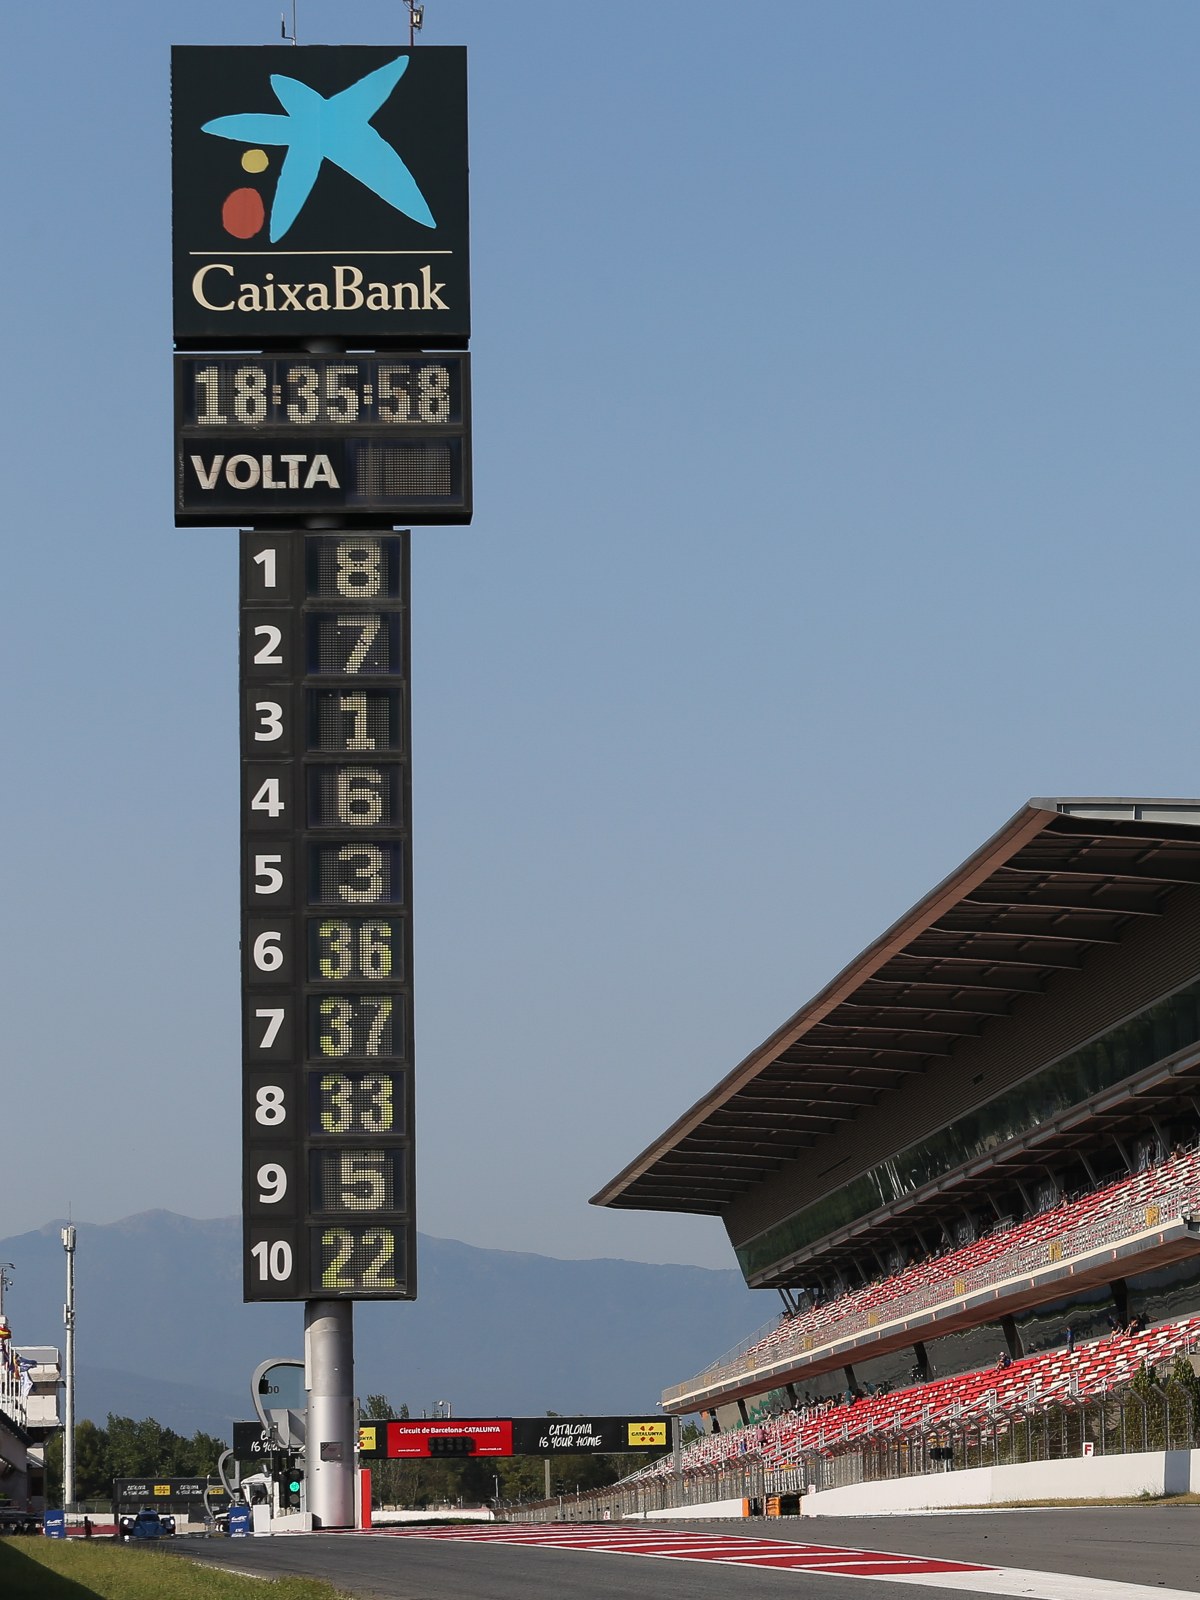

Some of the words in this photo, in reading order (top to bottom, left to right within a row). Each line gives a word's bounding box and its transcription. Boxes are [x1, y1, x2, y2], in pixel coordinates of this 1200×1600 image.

[193, 264, 450, 312] CaixaBank
[194, 365, 451, 425] 18:35:58
[190, 455, 340, 490] VOLTA
[254, 549, 276, 587] 1
[336, 540, 381, 597] 8
[253, 625, 283, 665] 2
[337, 615, 381, 674] 7
[254, 702, 284, 741] 3
[340, 691, 375, 750] 1
[251, 778, 285, 817] 4
[338, 766, 382, 826] 6
[255, 855, 284, 894] 5
[338, 843, 382, 902] 3
[253, 931, 284, 971] 6
[319, 919, 392, 979] 36
[255, 1009, 285, 1048] 7
[319, 996, 393, 1056] 37
[255, 1085, 286, 1126] 8
[320, 1072, 393, 1133] 33
[256, 1163, 288, 1203] 9
[341, 1150, 385, 1210] 5
[251, 1240, 293, 1281] 10
[322, 1227, 395, 1288] 22
[431, 1426, 500, 1434] Barcelona-CATALUNYA
[539, 1437, 549, 1448] IS
[551, 1436, 573, 1448] YOUR
[576, 1435, 602, 1447] HOME
[549, 1423, 592, 1436] CATALONIA
[1085, 1444, 1092, 1455] F
